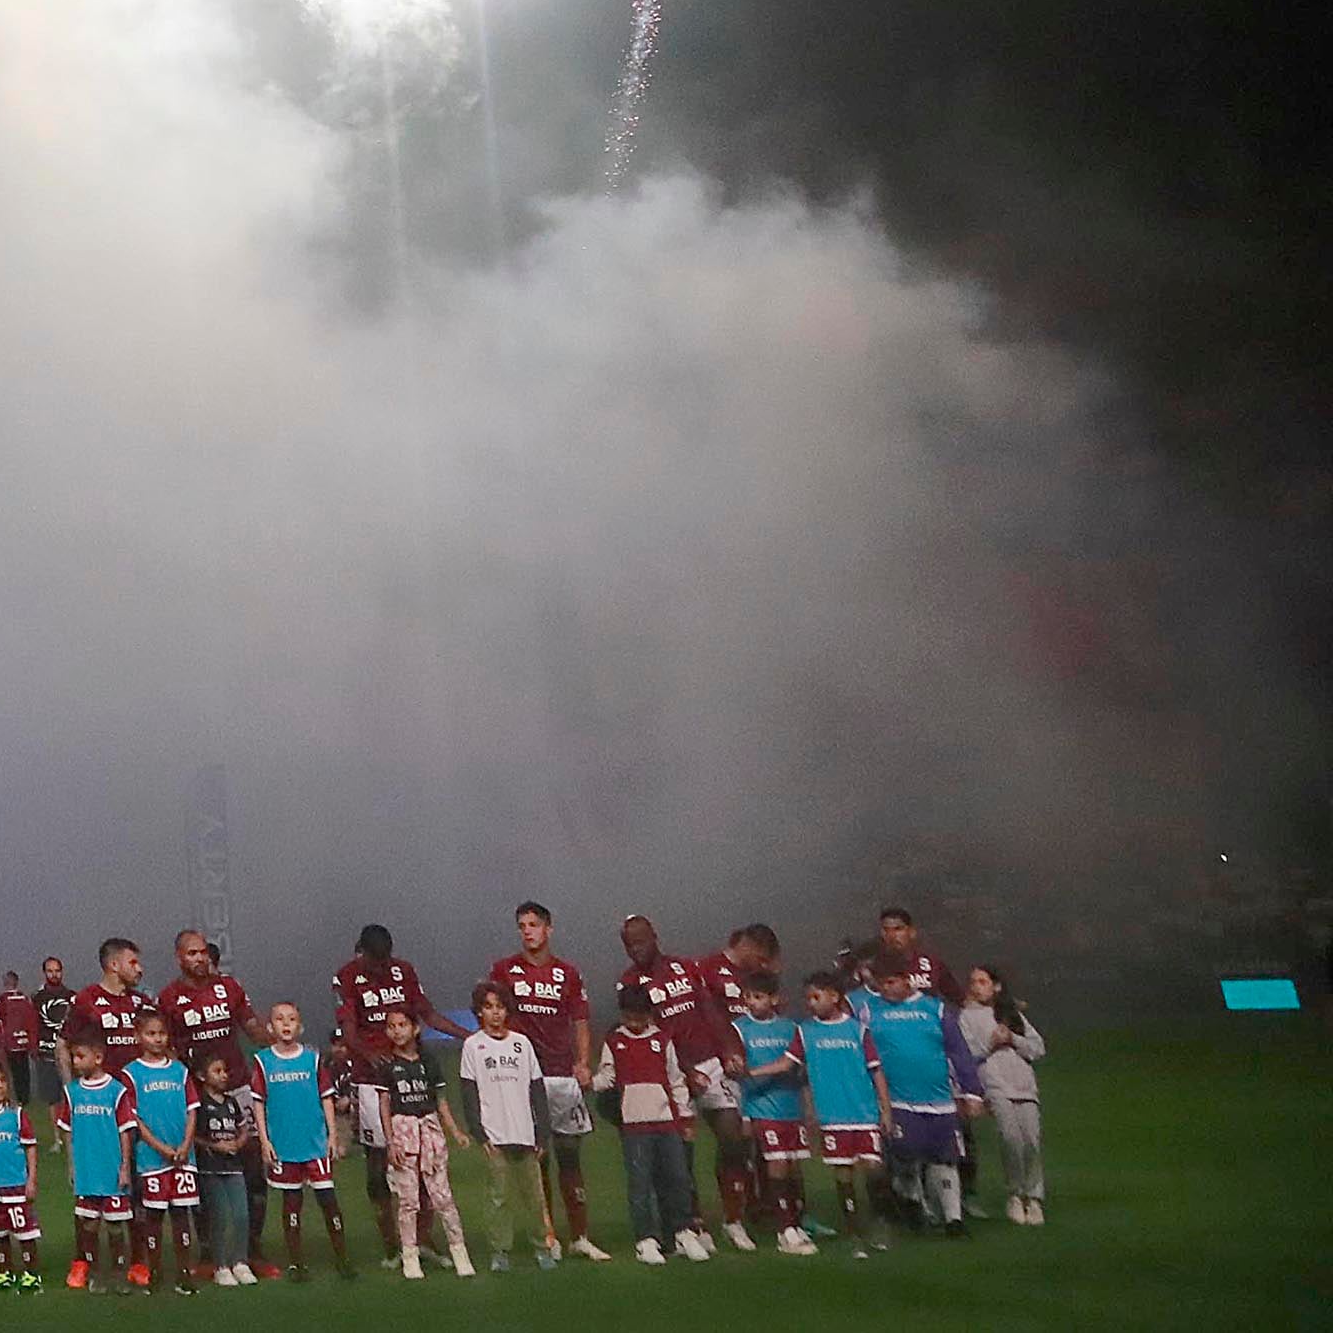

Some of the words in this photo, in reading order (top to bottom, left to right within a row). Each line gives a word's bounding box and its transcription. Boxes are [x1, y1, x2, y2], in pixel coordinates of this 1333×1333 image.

[391, 967, 403, 981] S
[552, 968, 565, 983] S
[670, 962, 685, 975] S
[213, 984, 227, 999] S
[379, 986, 404, 1000] BAC
[535, 982, 562, 997] BAC
[665, 978, 693, 995] BAC
[202, 1003, 230, 1019] BAC
[518, 1004, 558, 1016] LIBERTY
[661, 1001, 695, 1019] LIBERTY
[107, 1036, 138, 1045] LIBER
[193, 1027, 230, 1041] LIBERTY
[513, 1042, 522, 1053] S
[499, 1056, 519, 1066] BAC
[269, 1072, 310, 1083] LIBERTY
[824, 1135, 837, 1151] S
[147, 1178, 160, 1193] S
[175, 1172, 196, 1194] 29
[8, 1206, 26, 1228] 16
